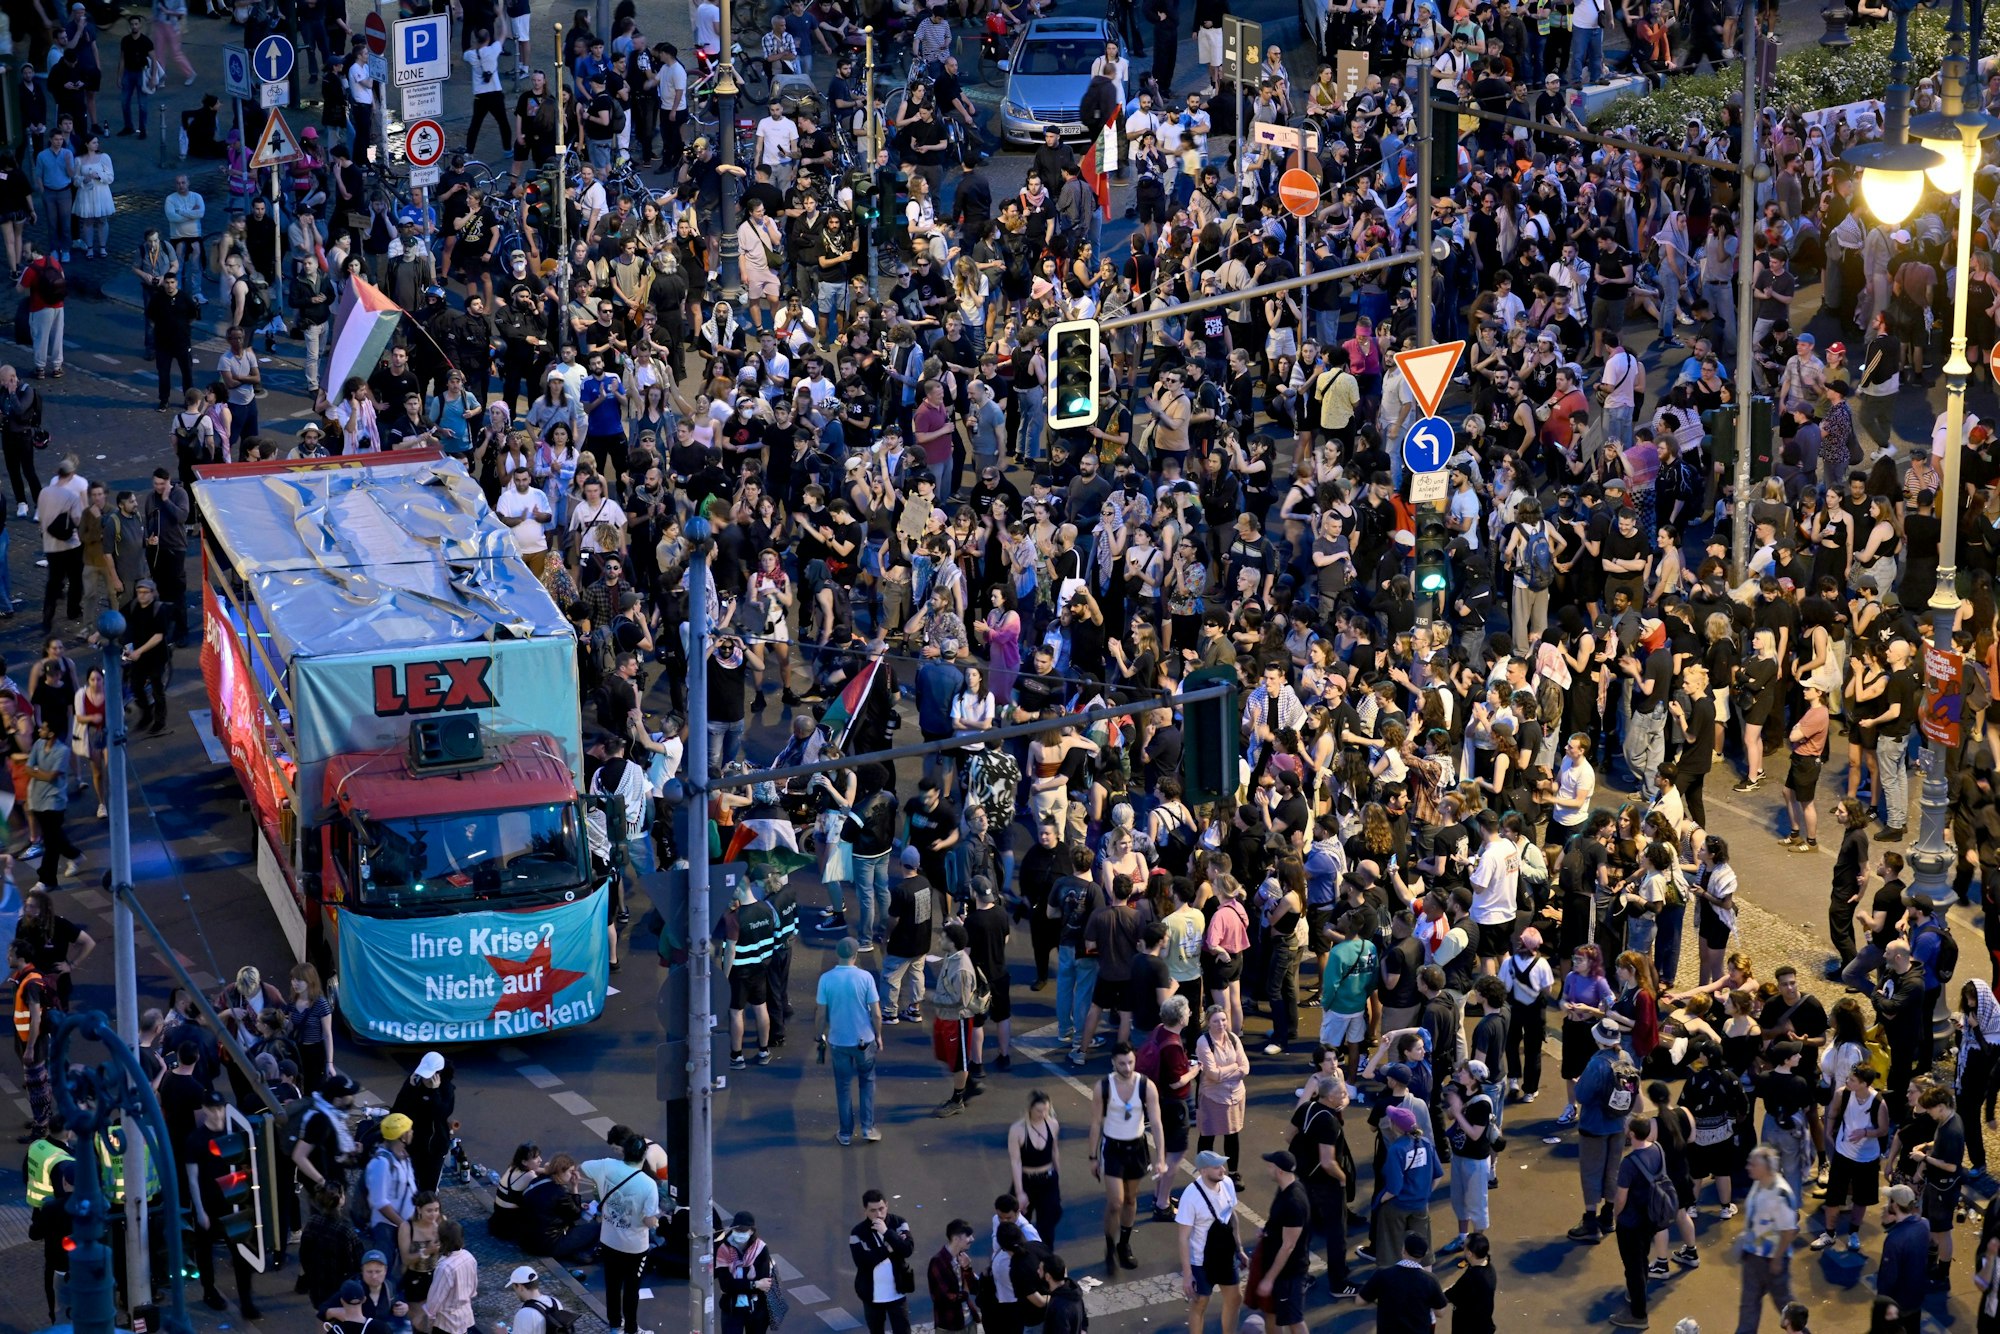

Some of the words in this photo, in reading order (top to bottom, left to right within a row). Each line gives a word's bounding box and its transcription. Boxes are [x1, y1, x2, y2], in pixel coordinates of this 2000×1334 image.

[412, 29, 430, 59] P
[398, 67, 424, 81] ZONE
[413, 169, 435, 178] Anlieger
[1204, 317, 1223, 329] FCK
[1205, 326, 1224, 336] AFD
[372, 656, 500, 717] LEX
[749, 918, 770, 930] Technik
[411, 932, 463, 959] Ihre
[469, 922, 555, 956] Krise?
[425, 972, 495, 1001] Nicht
[502, 966, 544, 995] auf
[494, 990, 597, 1036] Rücken!
